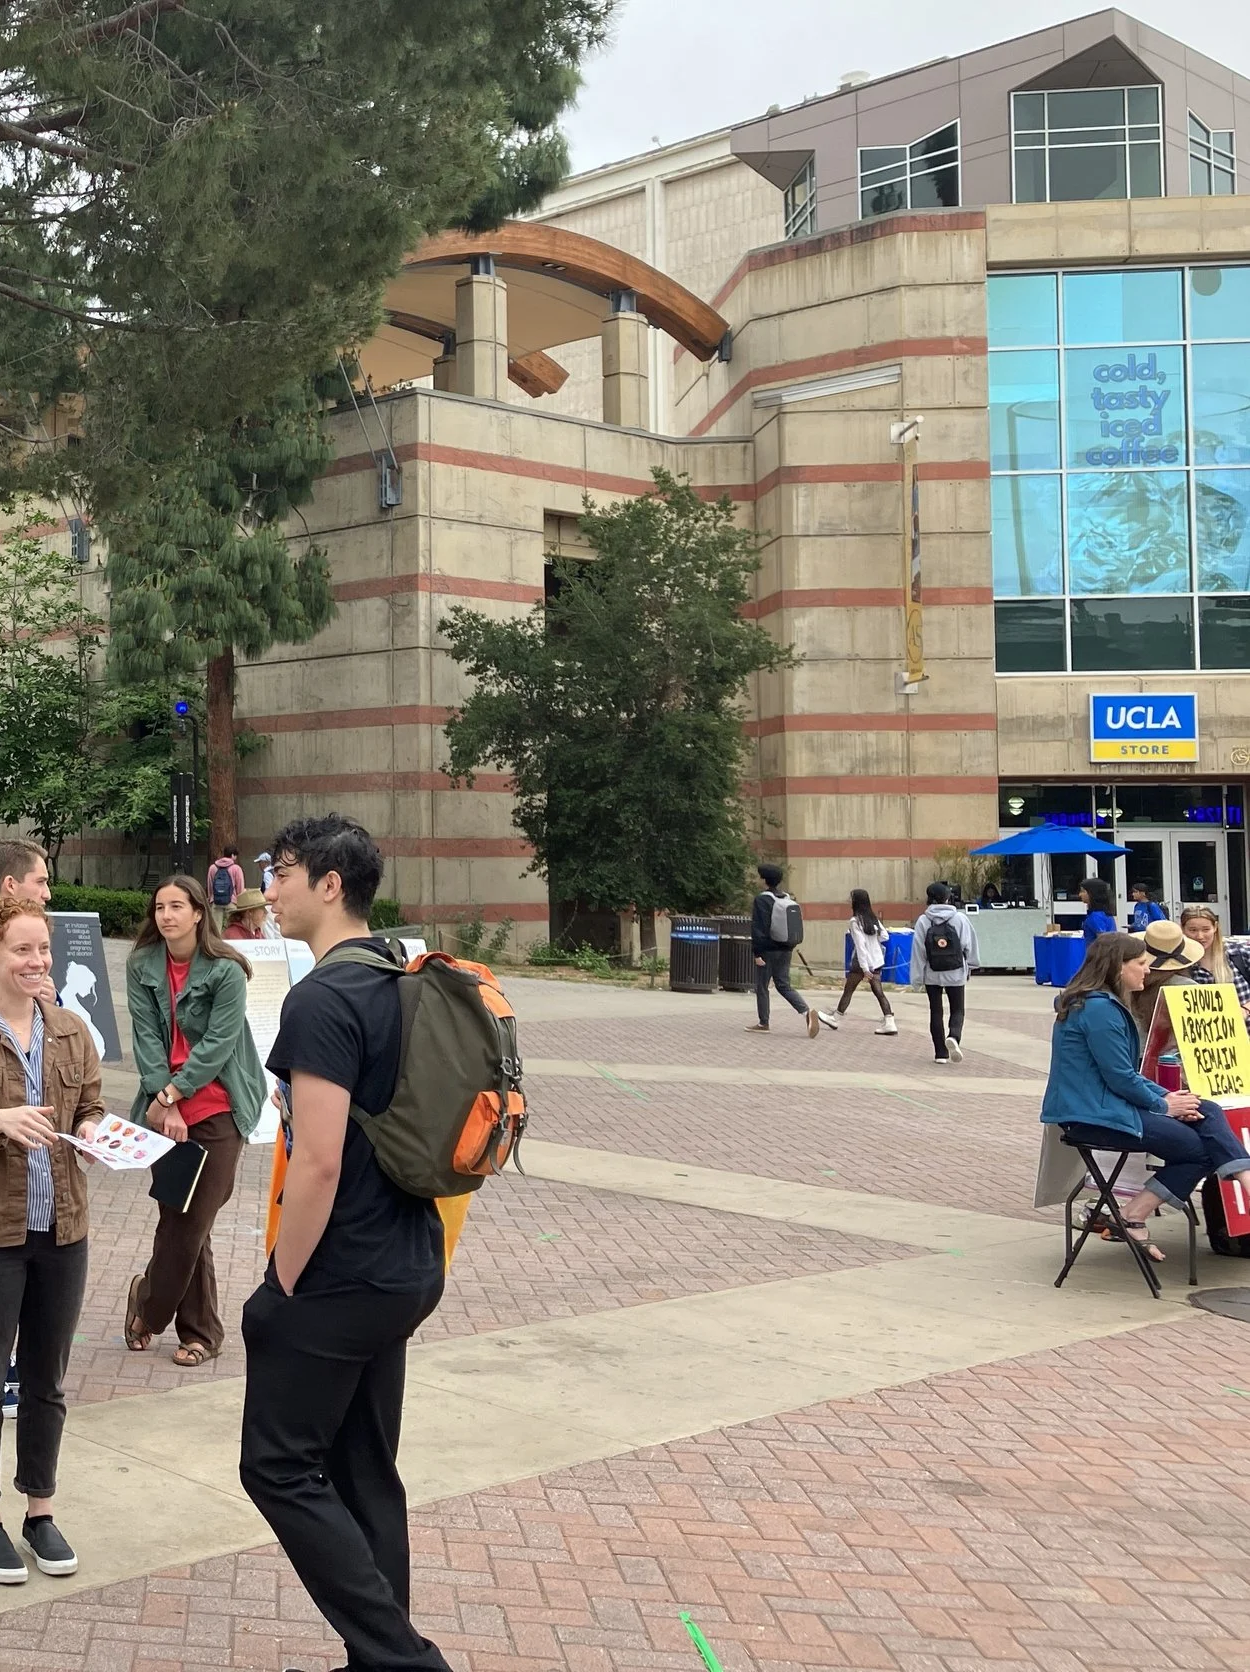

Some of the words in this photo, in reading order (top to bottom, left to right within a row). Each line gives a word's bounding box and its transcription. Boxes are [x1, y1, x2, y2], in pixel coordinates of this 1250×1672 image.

[1093, 353, 1166, 385] cold,
[1091, 385, 1171, 415] tasty
[1100, 409, 1162, 438] iced
[1086, 436, 1179, 465] coffee
[1106, 706, 1181, 729] UCLA
[1121, 745, 1169, 755] STORE
[254, 945, 281, 957] STORY
[1183, 989, 1224, 1014] SHOULD
[1181, 1015, 1236, 1043] ABORTION
[1194, 1046, 1238, 1074] REMAIN
[1207, 1073, 1244, 1096] LEGAL?
